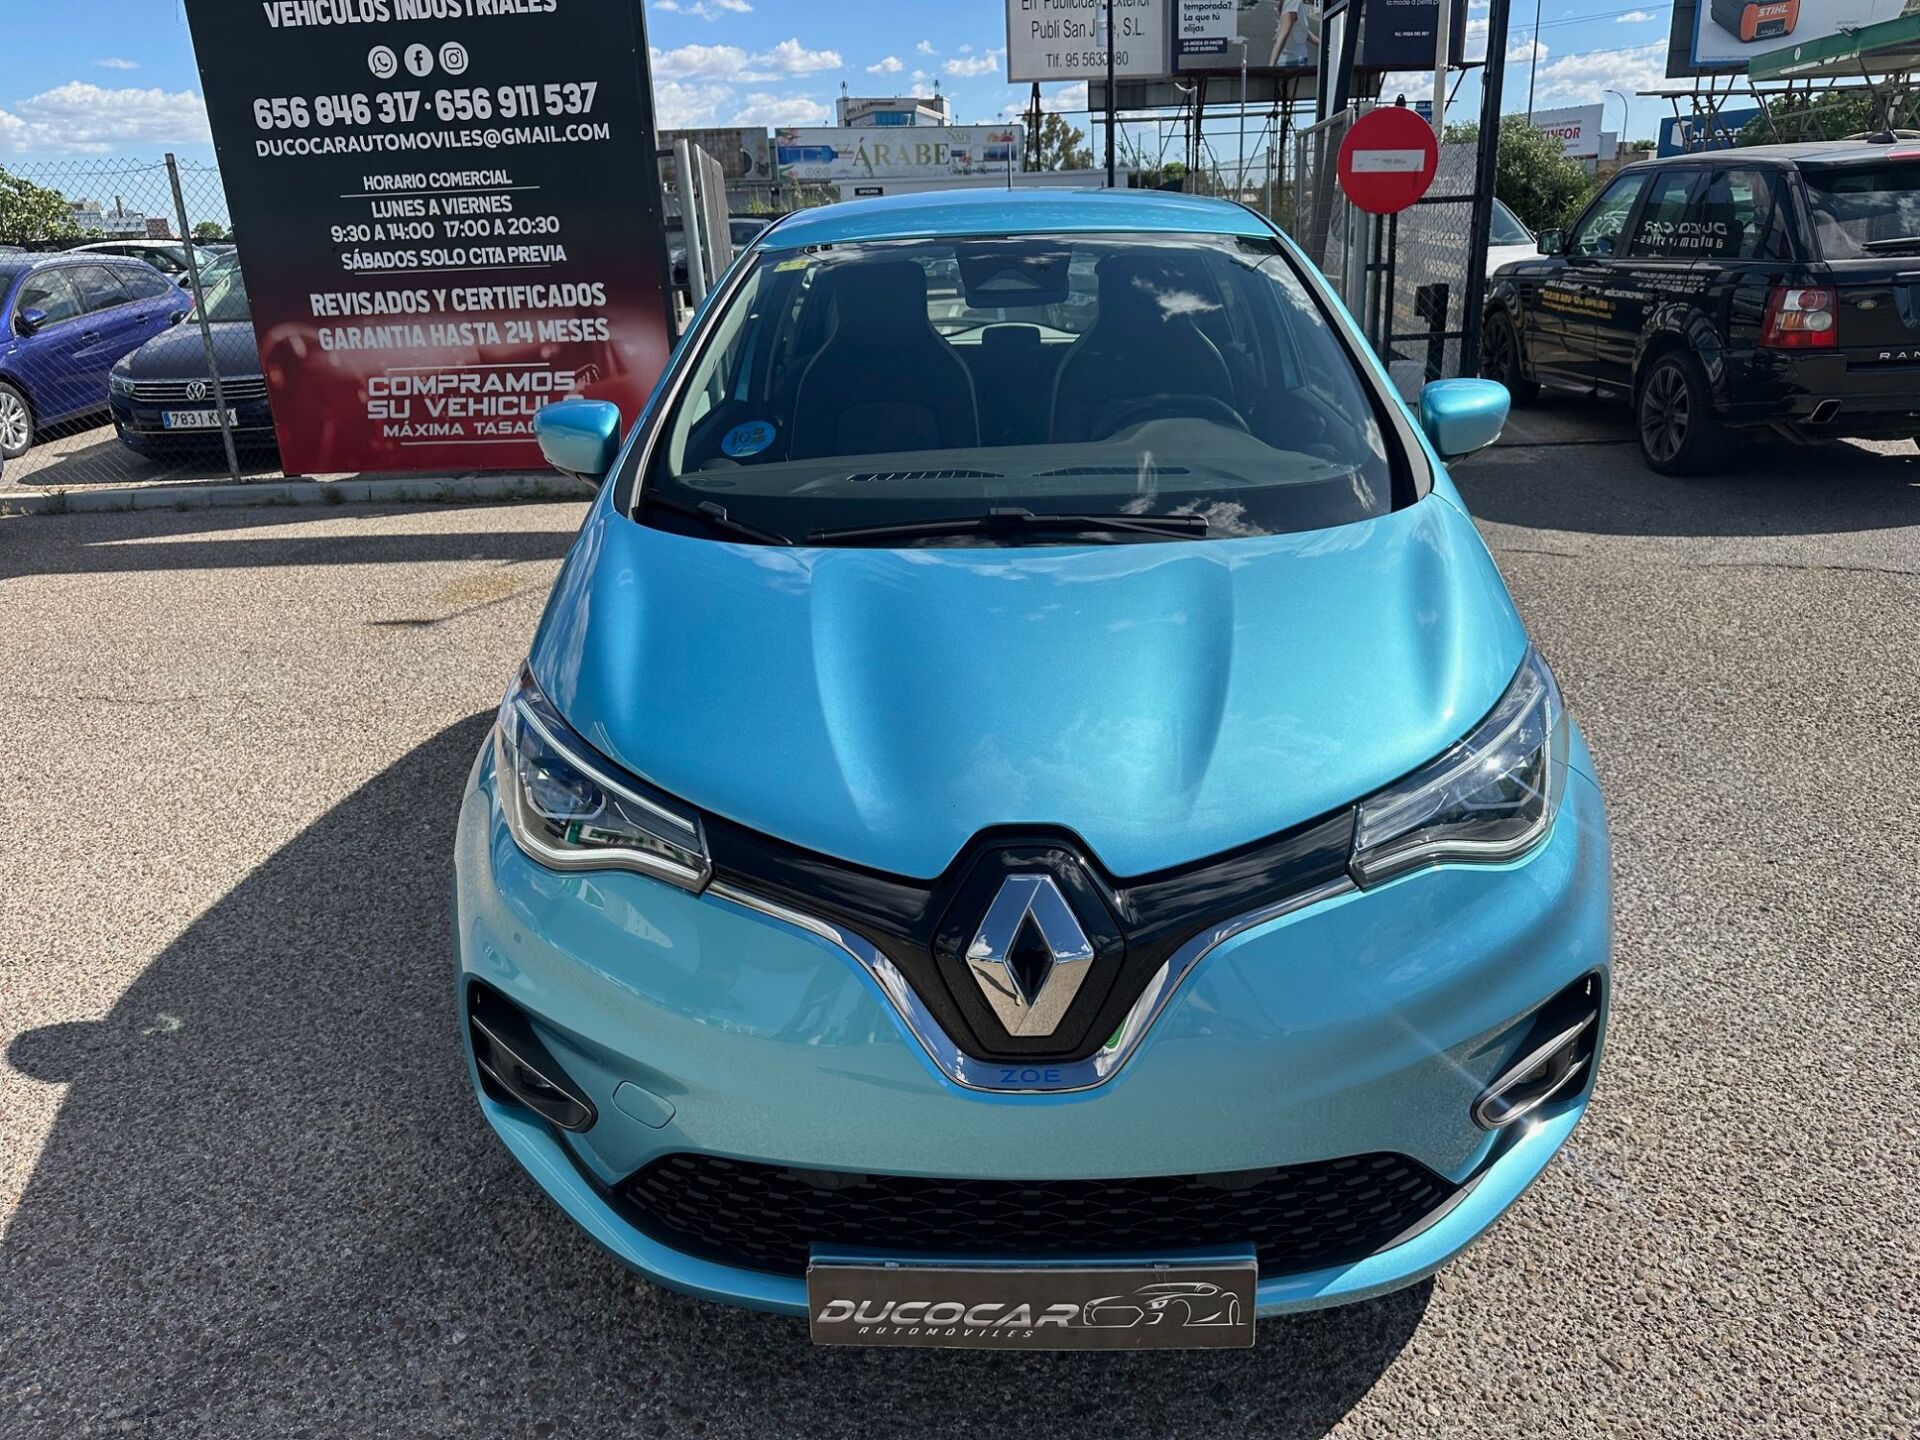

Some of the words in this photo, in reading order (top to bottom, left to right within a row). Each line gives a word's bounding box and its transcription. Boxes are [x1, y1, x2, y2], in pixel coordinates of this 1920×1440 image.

[1183, 0, 1233, 12] temporada?
[1758, 4, 1789, 17] STIHL
[1032, 20, 1060, 39] Publi
[1063, 19, 1086, 38] San
[1123, 17, 1146, 36] S.L.
[1195, 14, 1211, 23] que
[1045, 52, 1063, 68] Tlf.
[1065, 52, 1079, 67] 95
[253, 97, 311, 130] 656
[314, 93, 372, 126] 846
[376, 91, 421, 123] 317
[435, 87, 493, 121] 656
[497, 84, 541, 118] 911
[544, 80, 598, 115] 537
[256, 122, 611, 158] DUCOCARAUTOMOVILES@GMAIL.COM
[853, 136, 950, 167] ÁRABE
[363, 172, 428, 191] HORARIO
[429, 168, 513, 189] COMERCIAL
[371, 199, 426, 219] LUNES
[428, 199, 441, 216] A
[441, 195, 513, 215] VIERNES
[331, 224, 371, 243] 9:30
[374, 223, 387, 241] A
[388, 222, 435, 241] 14:00
[443, 218, 490, 238] 17:00
[493, 218, 507, 236] A
[508, 215, 560, 236] 20:30
[341, 247, 418, 271] SÁBADOS
[420, 247, 467, 267] SOLO
[468, 245, 507, 265] CITA
[507, 244, 568, 264] PREVIA
[309, 288, 430, 317] REVISADOS
[431, 288, 447, 311] Y
[450, 281, 607, 312] CERTIFICADOS
[319, 324, 426, 351] GARANTIA
[430, 321, 502, 348] HASTA
[504, 321, 535, 345] 24
[536, 316, 610, 344] MESES
[368, 370, 576, 398] COMPRAMOS
[172, 412, 204, 426] 7831
[367, 400, 411, 420] SU
[383, 421, 465, 438] MÁXIMA
[1000, 1069, 1061, 1083] ZOE
[816, 1300, 1081, 1328] DUCOCAR
